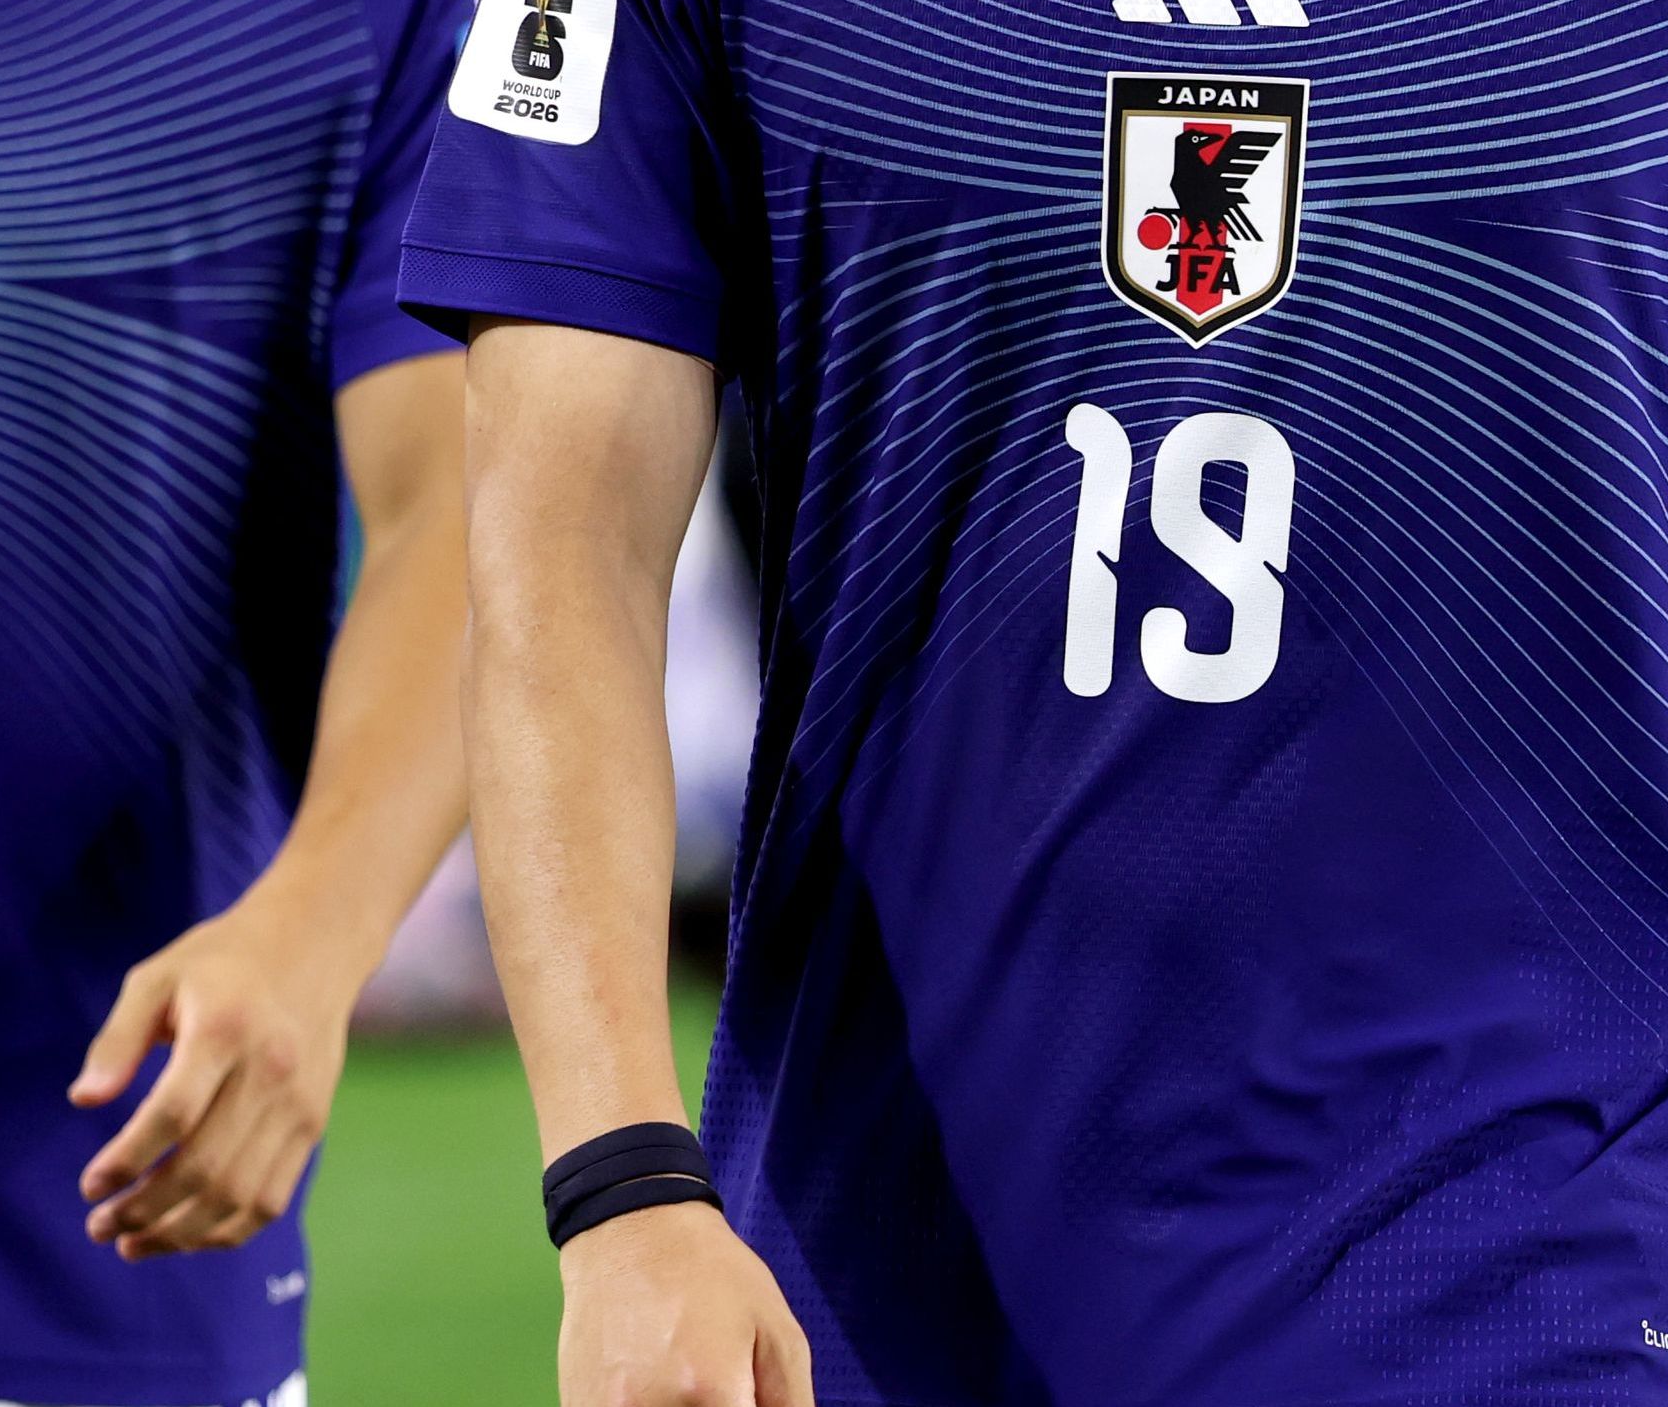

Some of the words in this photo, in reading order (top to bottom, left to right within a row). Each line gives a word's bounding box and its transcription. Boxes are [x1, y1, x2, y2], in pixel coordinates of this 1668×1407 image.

[528, 50, 551, 70] FIFA
[502, 79, 543, 98] WORLD
[543, 87, 562, 100] CUP
[1157, 85, 1260, 109] JAPAN
[493, 94, 560, 123] 2026
[1155, 253, 1242, 296] JFA
[1062, 402, 1297, 704] 19
